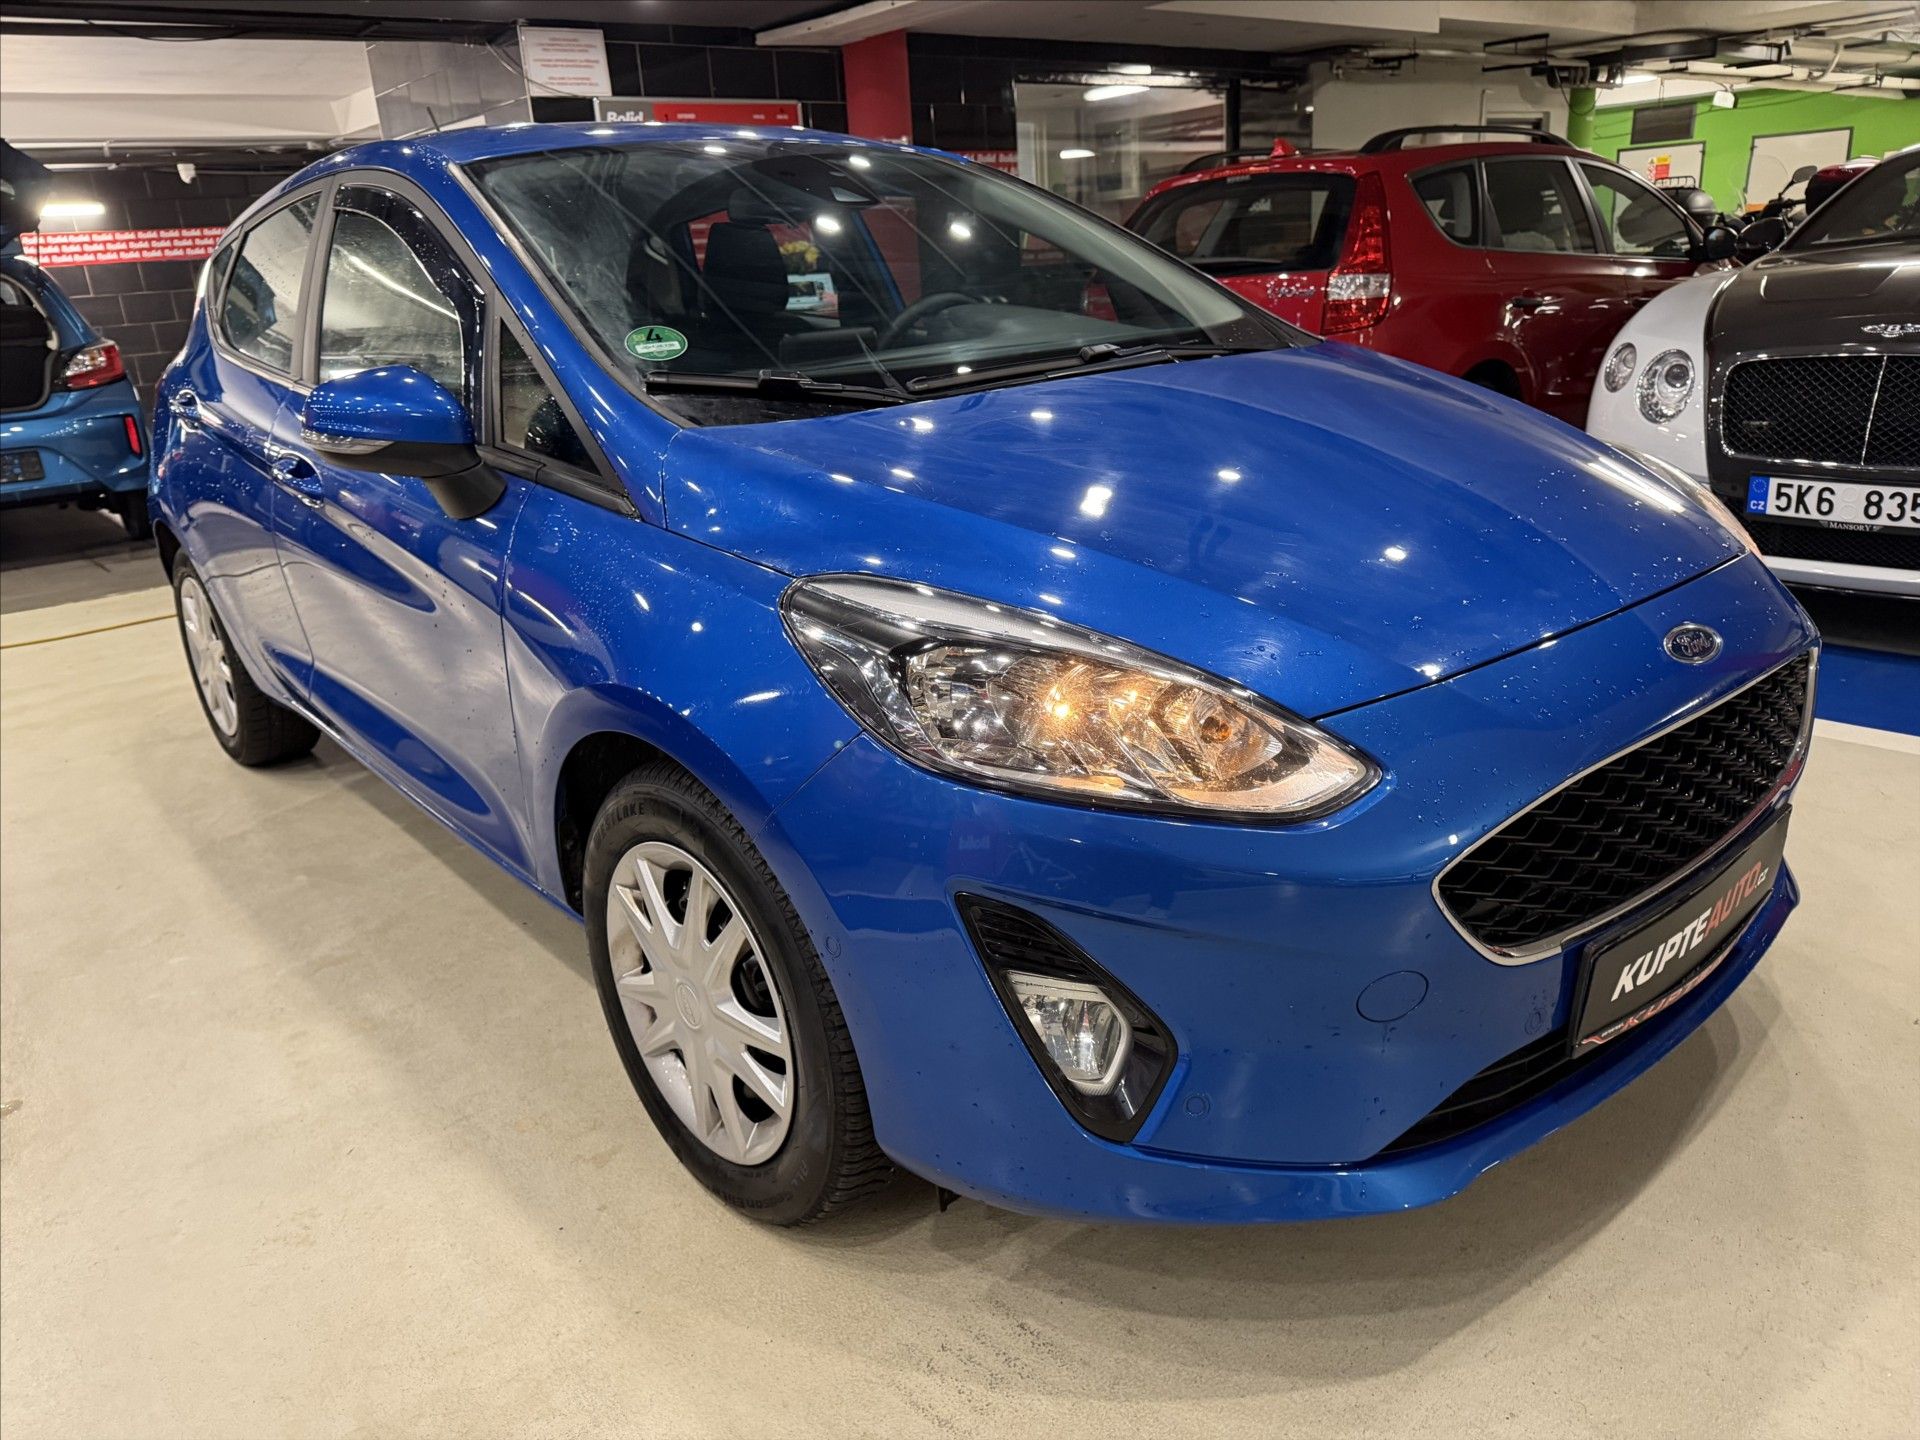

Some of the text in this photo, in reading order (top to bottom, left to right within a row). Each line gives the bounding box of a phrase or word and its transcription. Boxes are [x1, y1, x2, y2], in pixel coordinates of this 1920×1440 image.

[1774, 482, 1836, 516] 5K6
[1750, 500, 1765, 510] CZ
[1829, 521, 1872, 532] MANSORY
